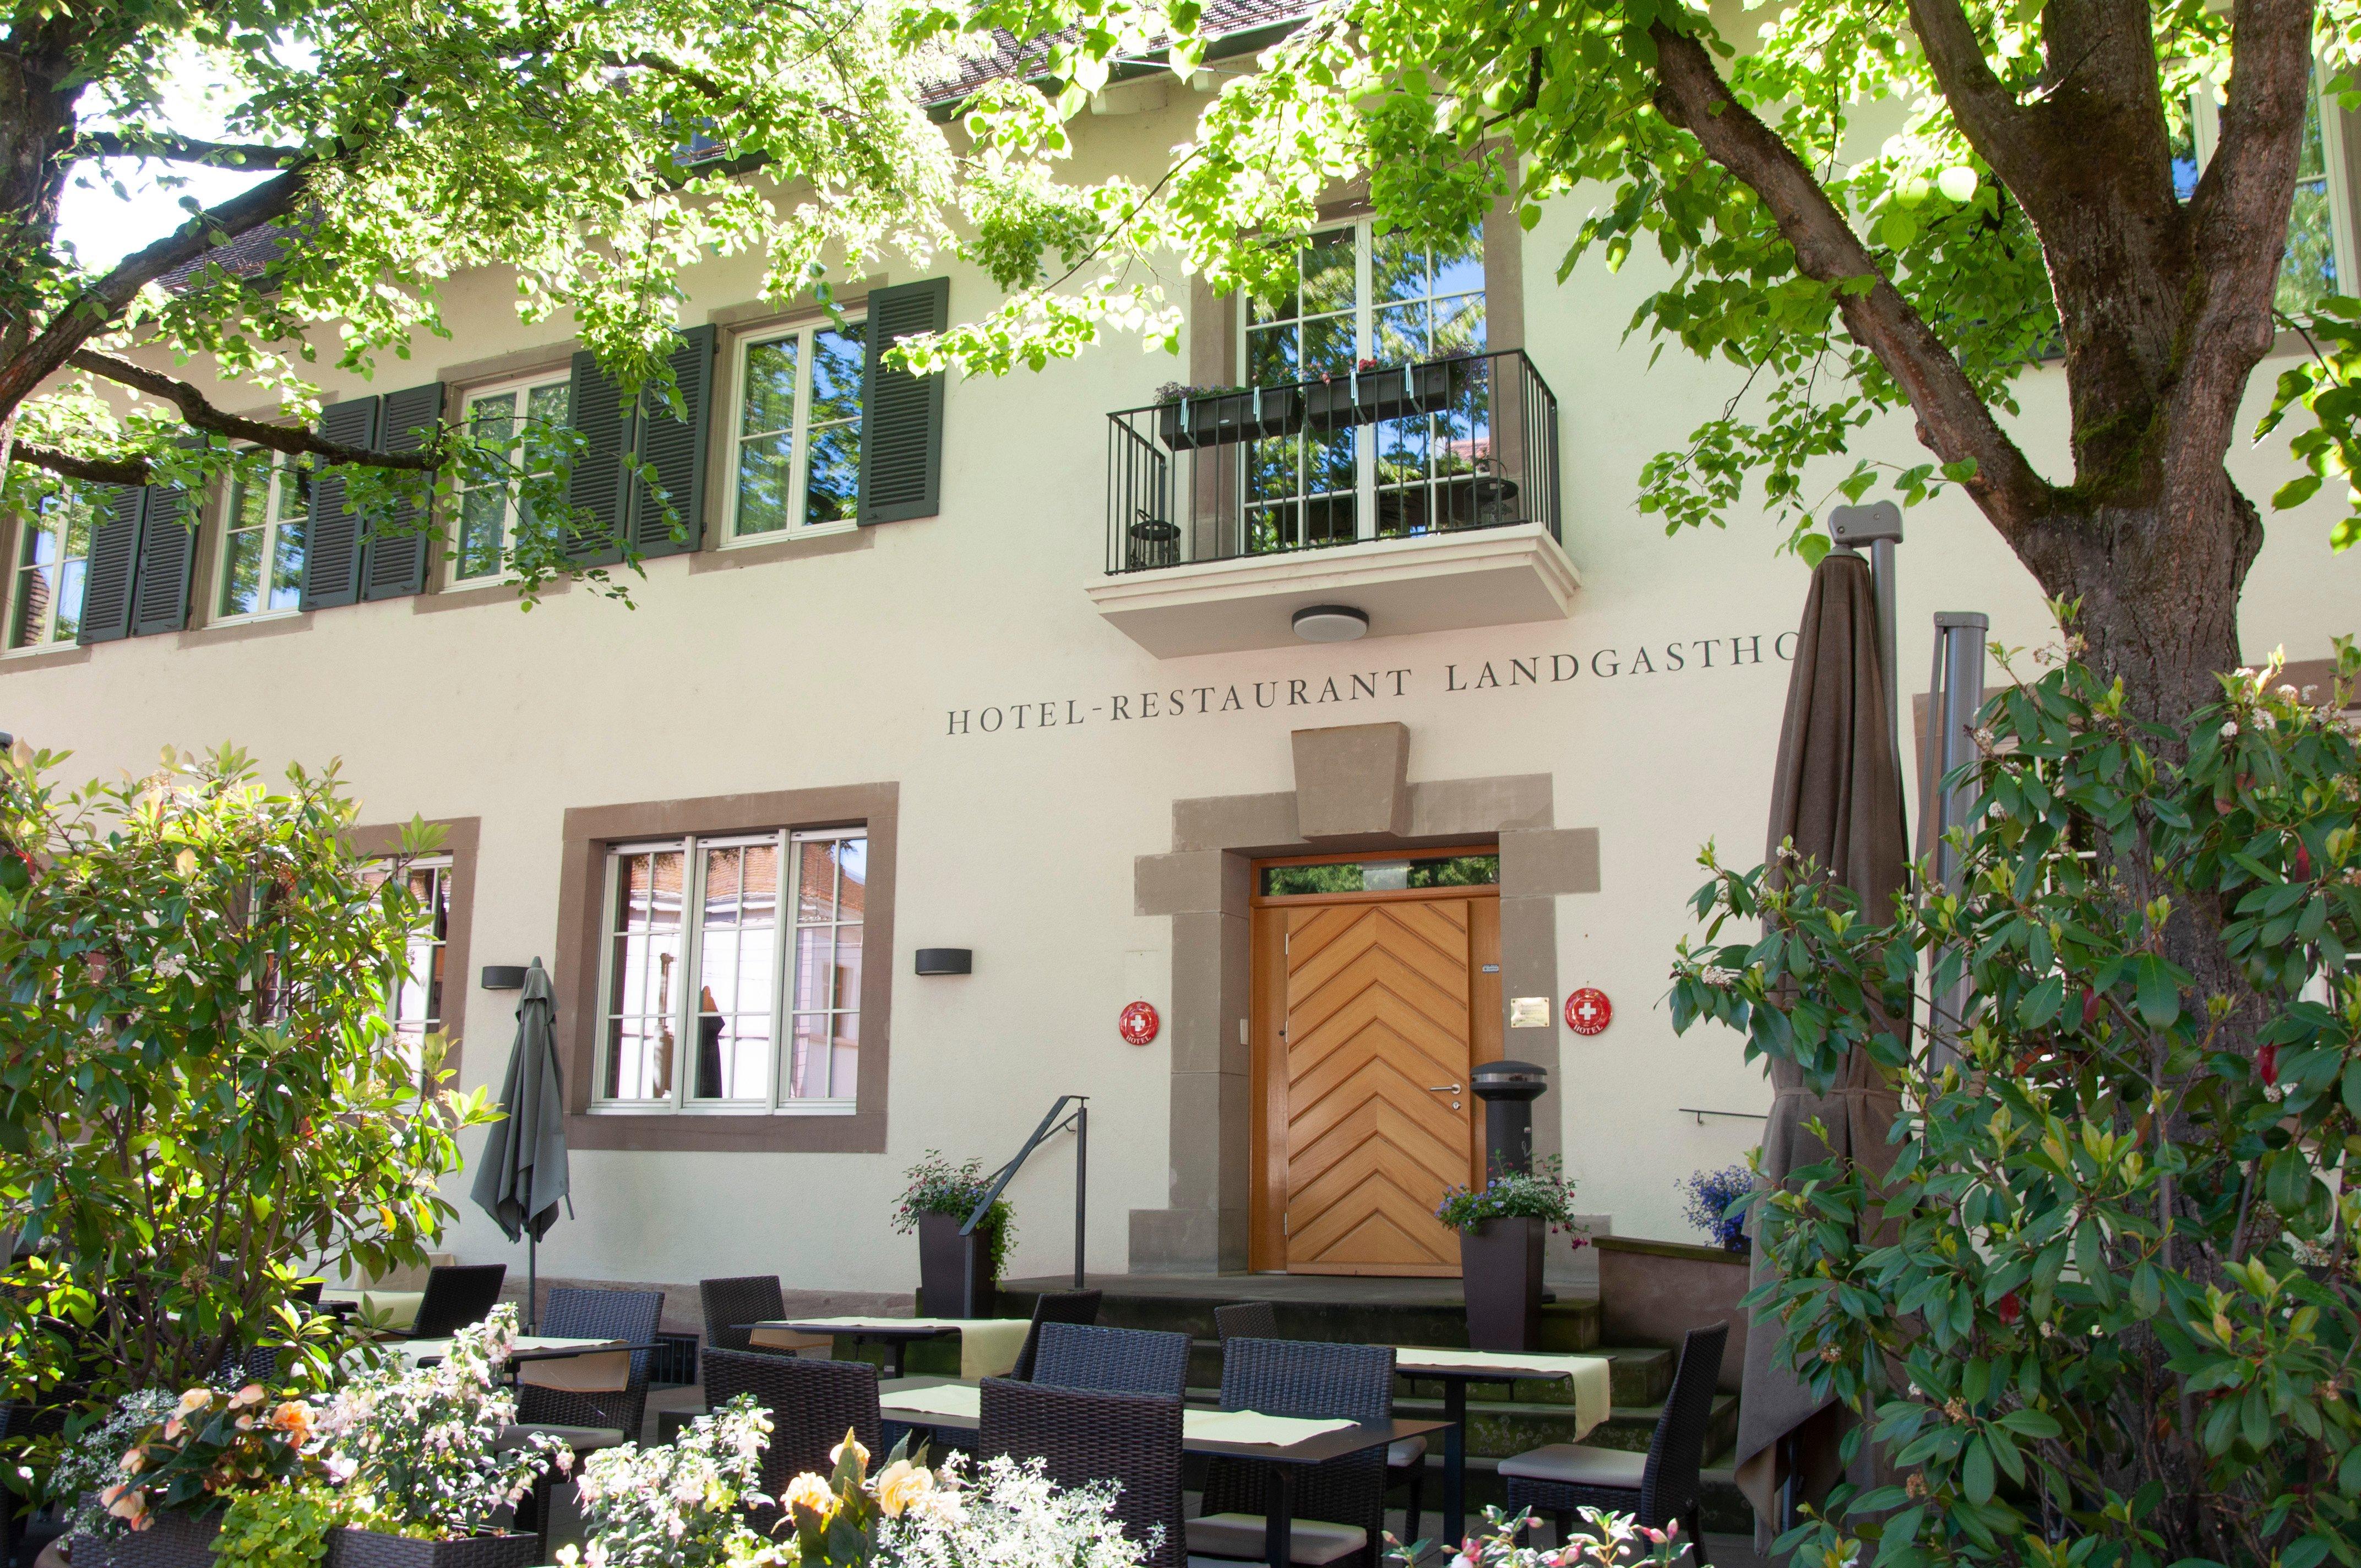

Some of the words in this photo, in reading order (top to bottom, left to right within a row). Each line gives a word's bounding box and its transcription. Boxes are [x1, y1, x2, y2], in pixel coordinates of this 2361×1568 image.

[946, 668, 1412, 736] HOTEL-RESTAURANT
[1445, 631, 1799, 692] LANDGASTHO
[1574, 1024, 1603, 1034] HOTEL
[1126, 1035, 1151, 1044] HOTEL
